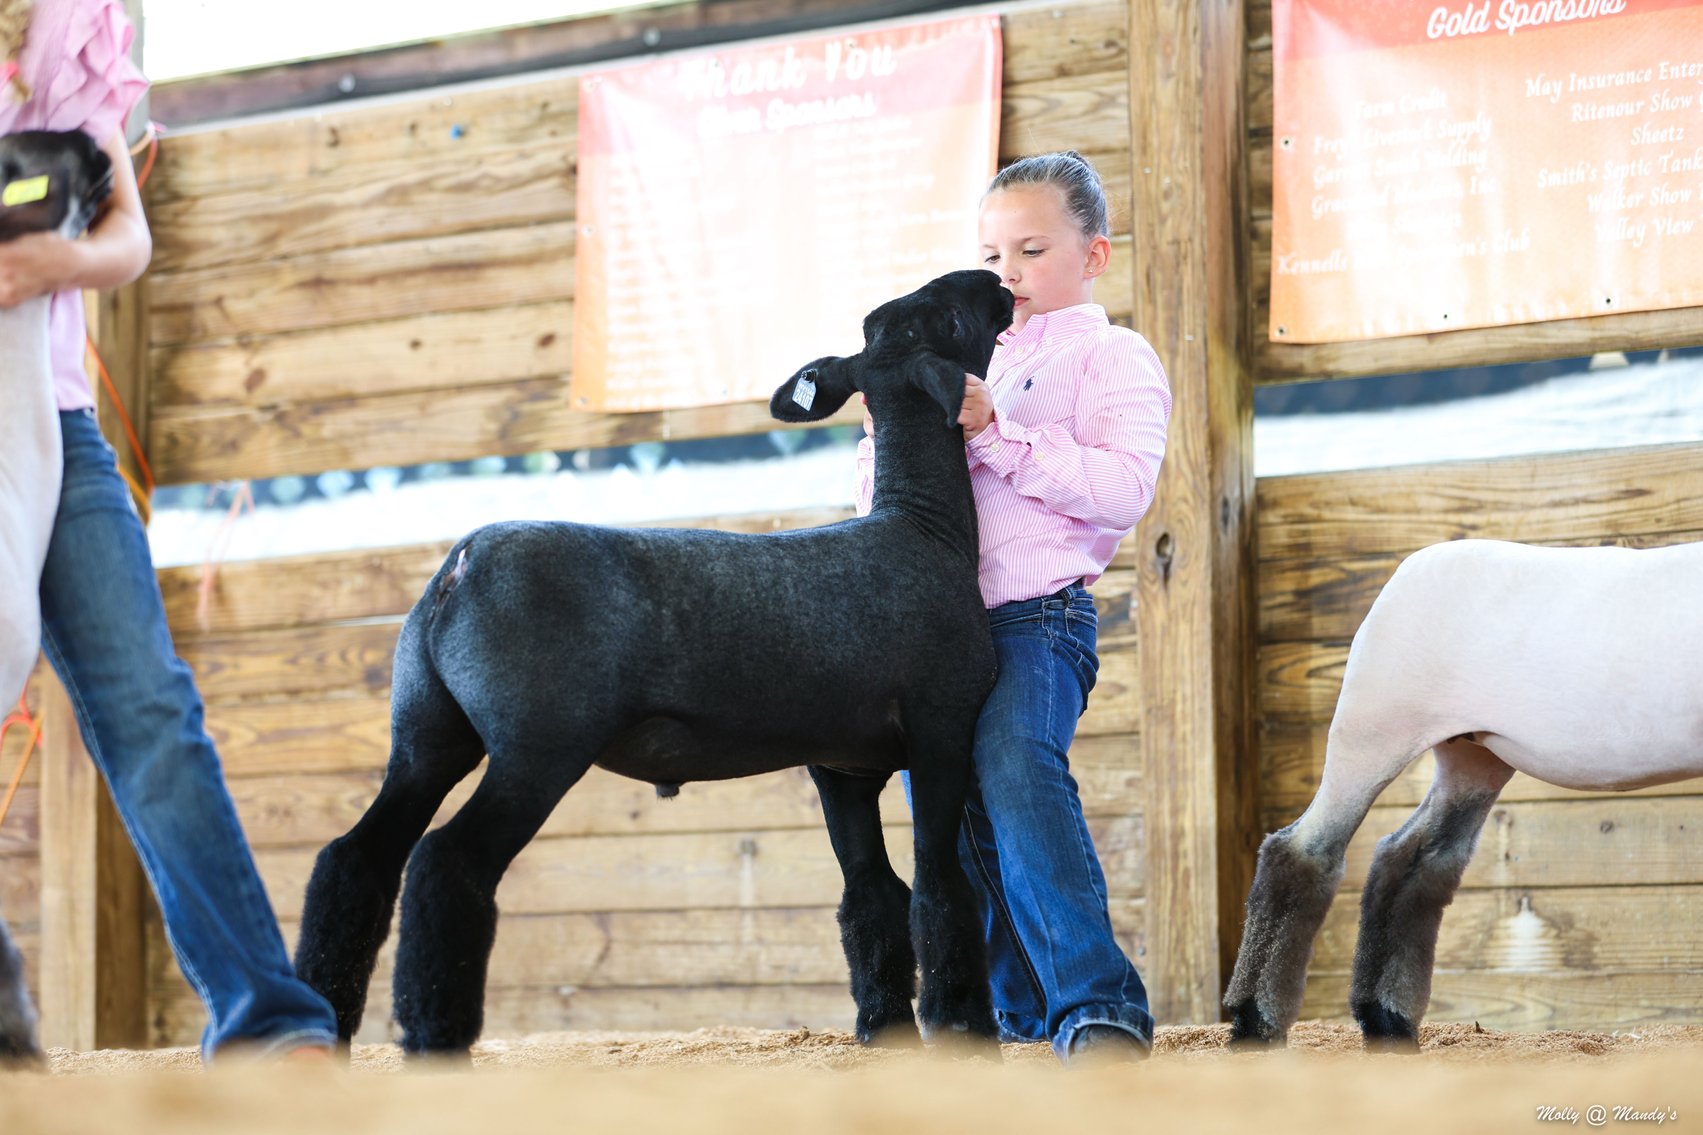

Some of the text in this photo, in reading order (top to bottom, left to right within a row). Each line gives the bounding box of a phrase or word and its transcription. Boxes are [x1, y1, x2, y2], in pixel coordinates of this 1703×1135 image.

[1427, 0, 1626, 39] Gold Sponsors
[680, 42, 897, 101] Thank You
[1525, 73, 1563, 103] May
[1568, 68, 1652, 92] Insurance
[1571, 100, 1645, 122] Ritenour
[1649, 89, 1694, 113] Show
[1437, 111, 1492, 145] Supply
[1631, 122, 1685, 146] Sheetz
[1537, 160, 1598, 188] Smith's
[1602, 158, 1652, 186] Septic
[1586, 187, 1644, 212] Walker
[1649, 182, 1693, 207] Show
[1595, 217, 1695, 248] Vlley View
